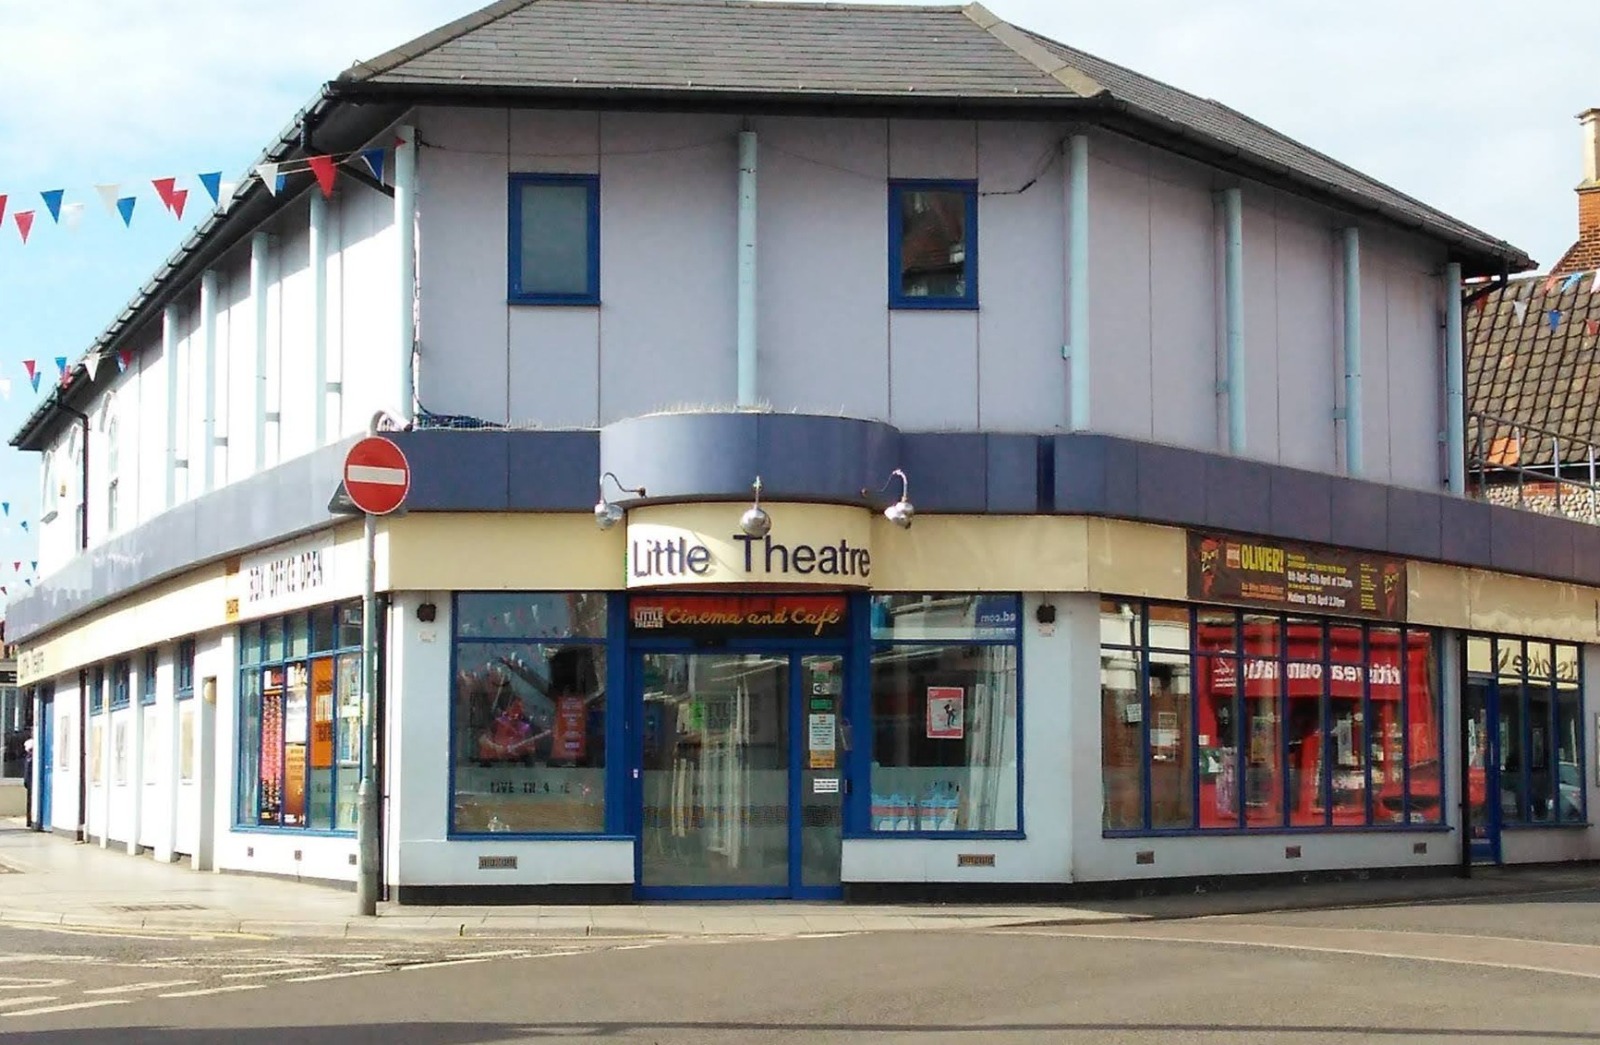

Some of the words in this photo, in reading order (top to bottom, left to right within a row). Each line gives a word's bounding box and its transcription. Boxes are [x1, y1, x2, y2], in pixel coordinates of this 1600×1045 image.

[633, 536, 711, 577] Little
[733, 534, 871, 578] Theatre
[1241, 544, 1284, 574] OLIVER!
[666, 608, 743, 625] Cinema
[747, 605, 789, 625] and
[790, 604, 840, 636] Café
